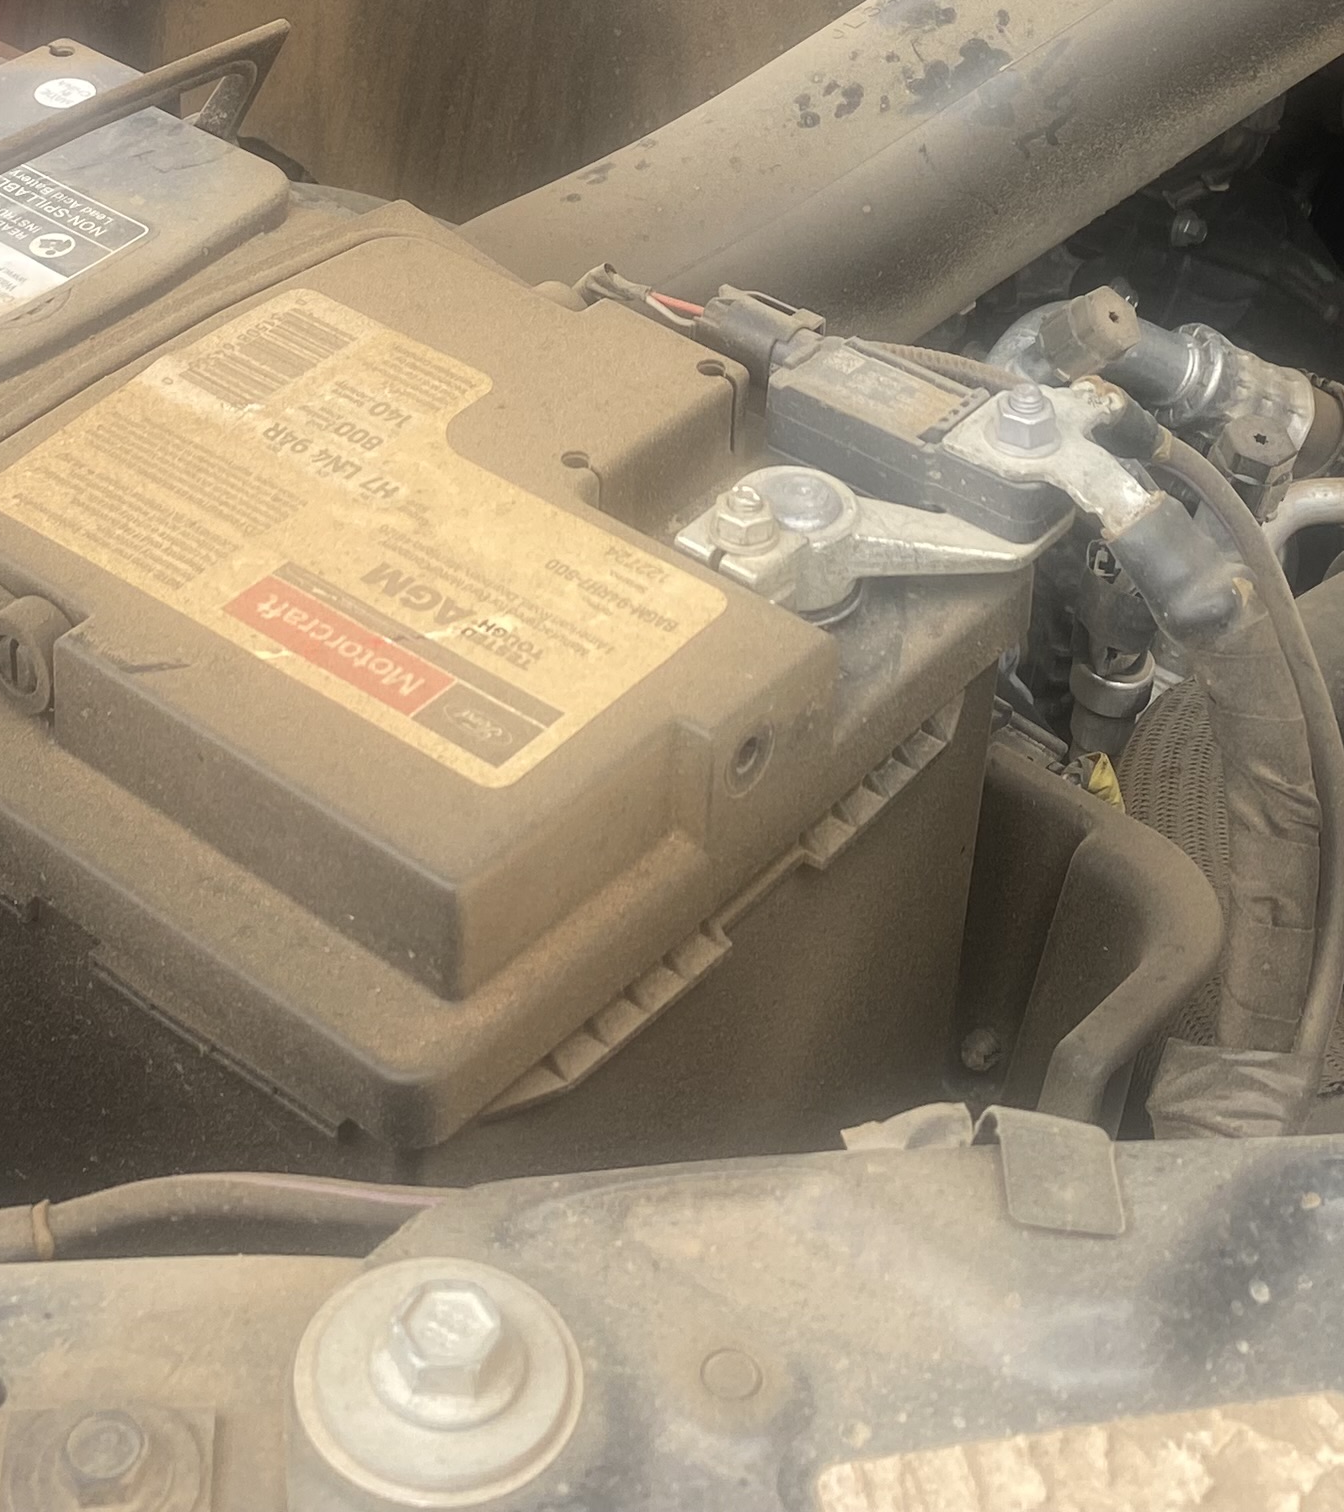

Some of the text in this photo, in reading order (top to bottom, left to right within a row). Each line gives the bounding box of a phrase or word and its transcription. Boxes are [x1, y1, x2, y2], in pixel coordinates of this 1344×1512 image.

[5, 168, 118, 224] Lead Acid Battery
[329, 419, 385, 452] 800
[364, 398, 415, 429] 140
[257, 421, 402, 501] H7 LN4 94R
[358, 560, 476, 631] AGM
[248, 591, 427, 697] Motorcraft
[457, 624, 536, 670] TESTED
